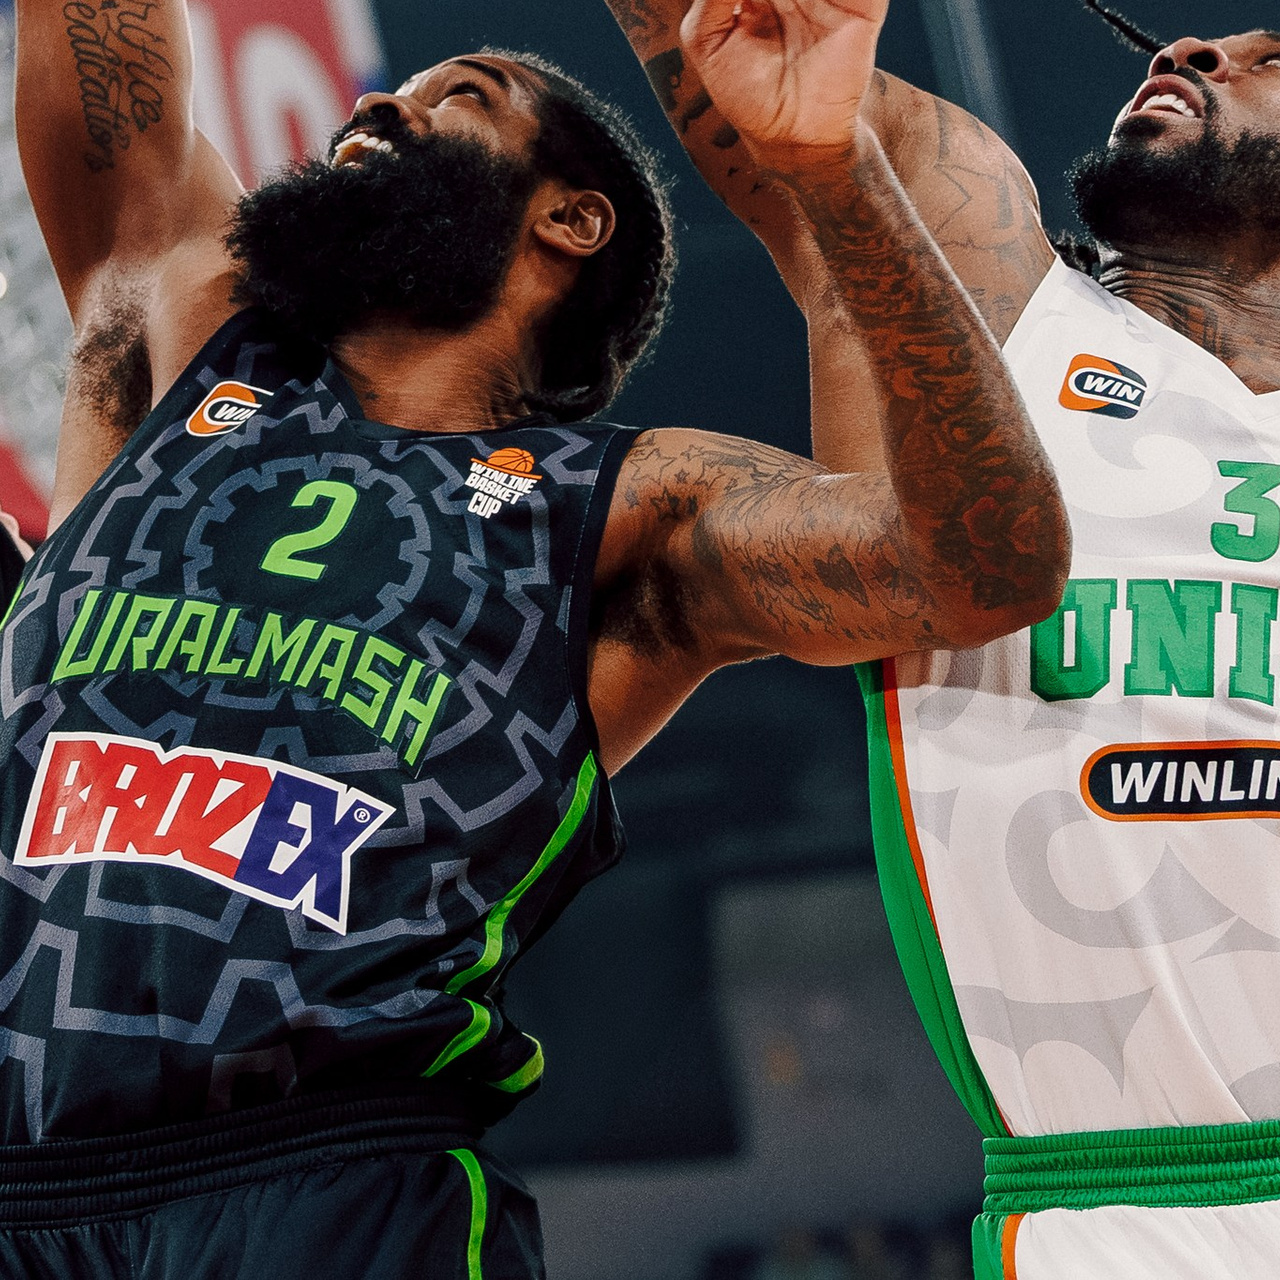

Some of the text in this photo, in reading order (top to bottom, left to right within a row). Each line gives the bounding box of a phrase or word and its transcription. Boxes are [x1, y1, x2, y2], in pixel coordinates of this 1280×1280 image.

[1083, 373, 1141, 401] WIN
[465, 472, 524, 505] BASKET
[470, 462, 538, 495] WINLINE
[467, 491, 502, 519] CUP
[260, 479, 358, 580] 2
[50, 589, 452, 768] URALMASH
[25, 740, 385, 923] BROZEX
